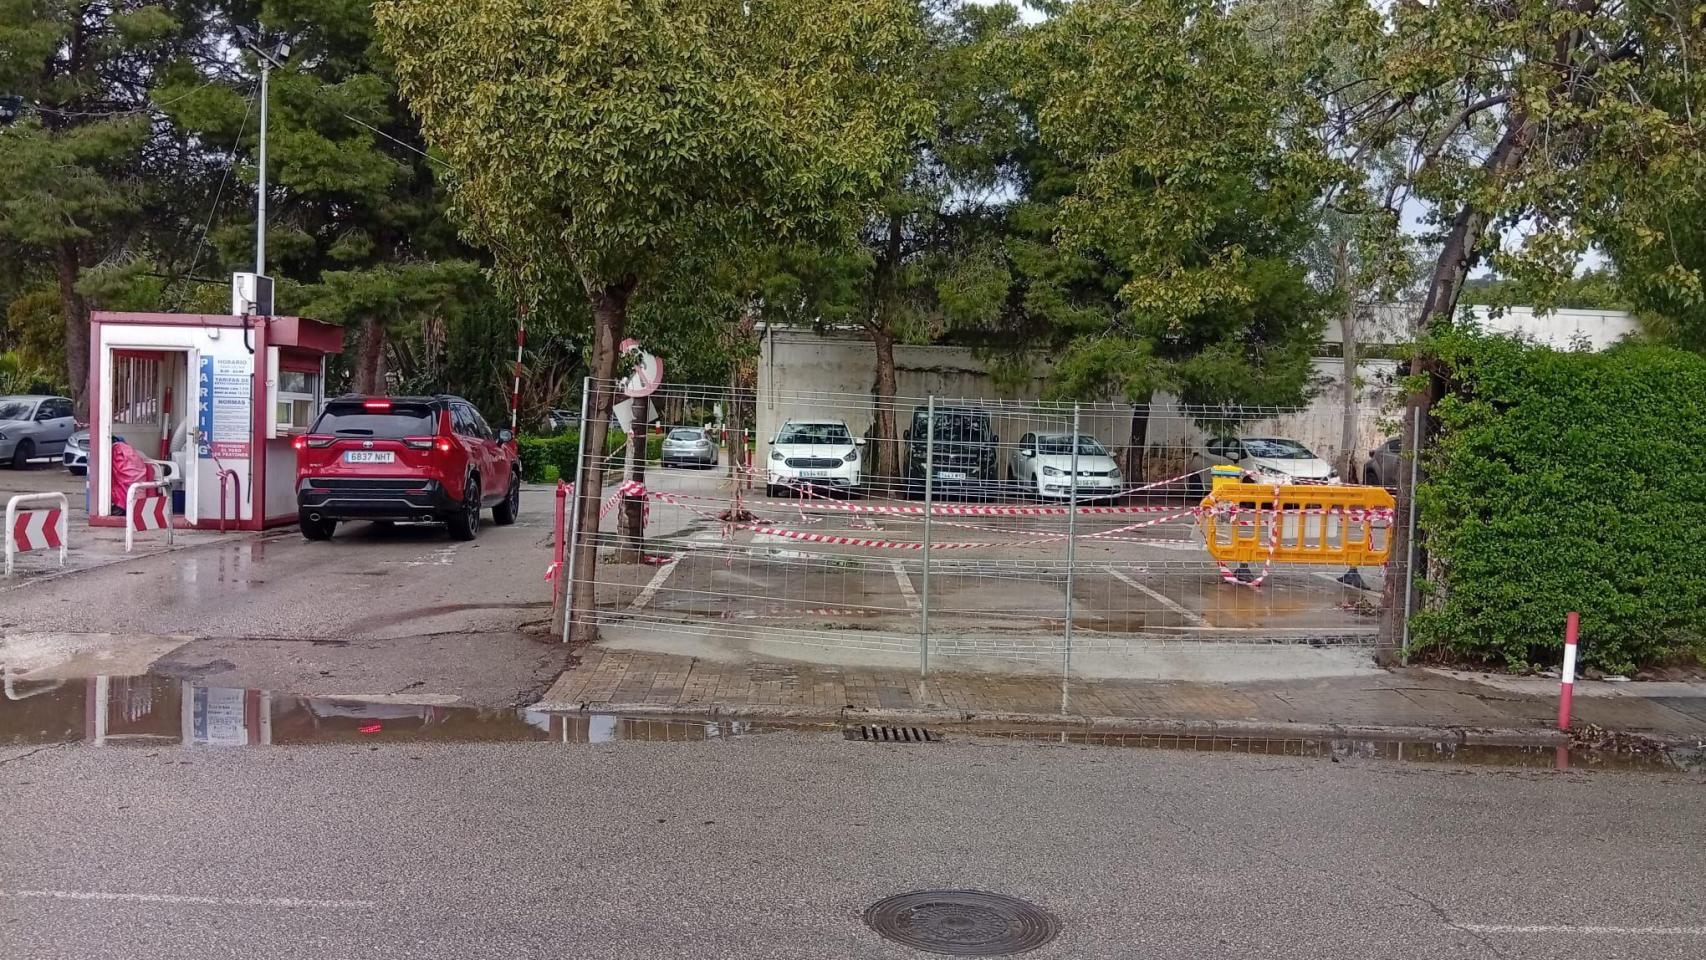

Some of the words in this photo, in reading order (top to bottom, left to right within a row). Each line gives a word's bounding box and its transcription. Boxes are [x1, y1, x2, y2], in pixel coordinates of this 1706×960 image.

[199, 358, 208, 455] PARKING
[351, 452, 373, 461] 6837
[375, 452, 391, 461] NHT
